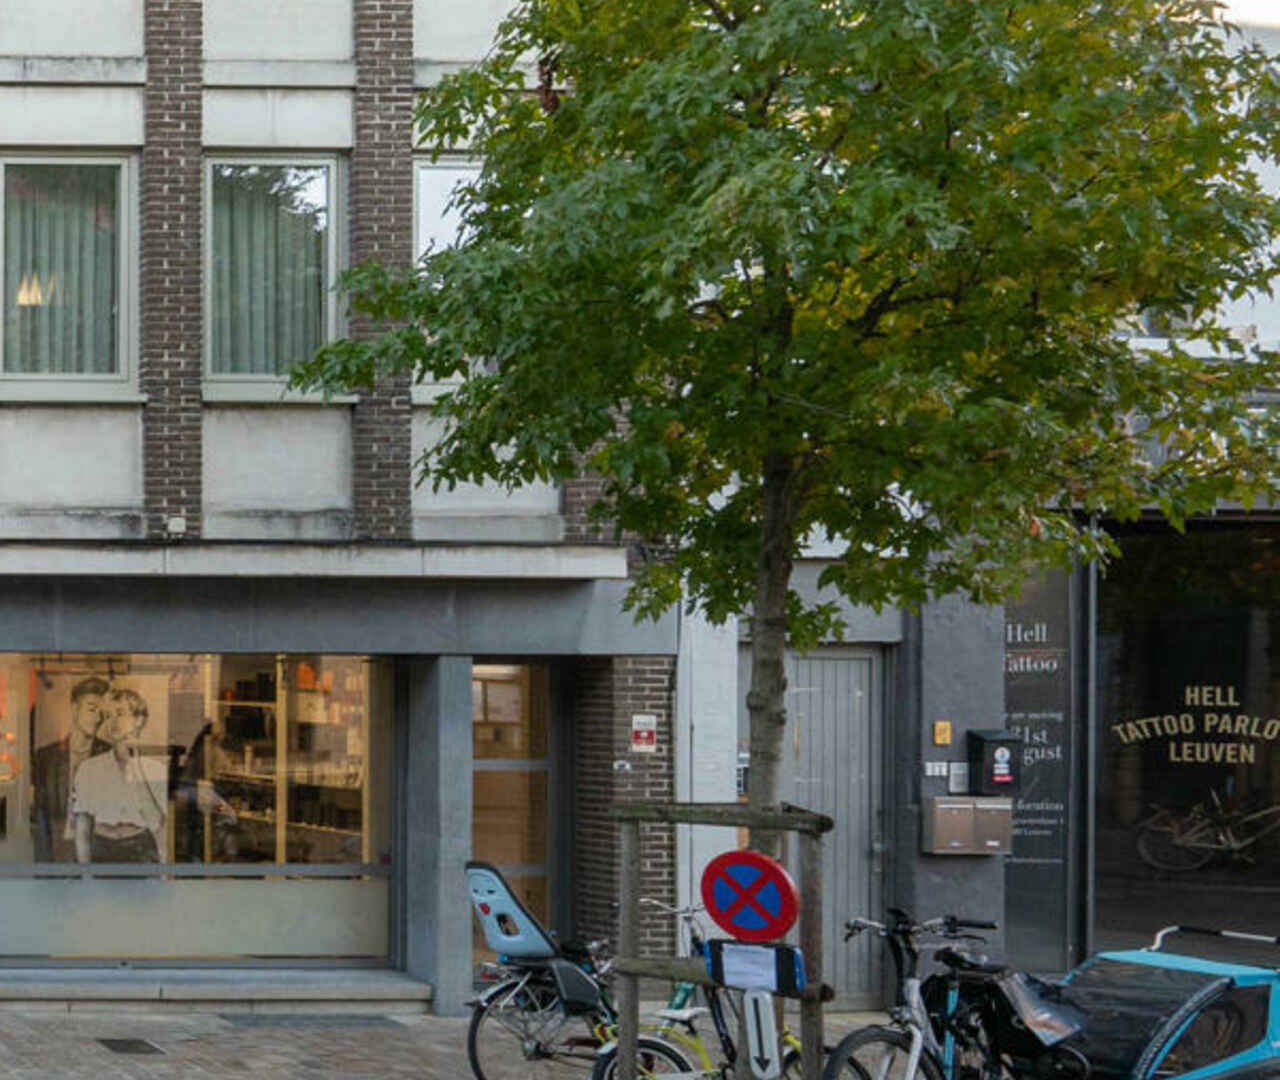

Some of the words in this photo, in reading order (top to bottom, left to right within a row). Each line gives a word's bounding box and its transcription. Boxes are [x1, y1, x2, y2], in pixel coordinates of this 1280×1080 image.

[1006, 623, 1048, 643] Hell
[1184, 685, 1240, 706] HELL
[1112, 713, 1195, 744] TATTOO
[1023, 746, 1062, 766] gust
[1168, 741, 1256, 764] LEUVEN
